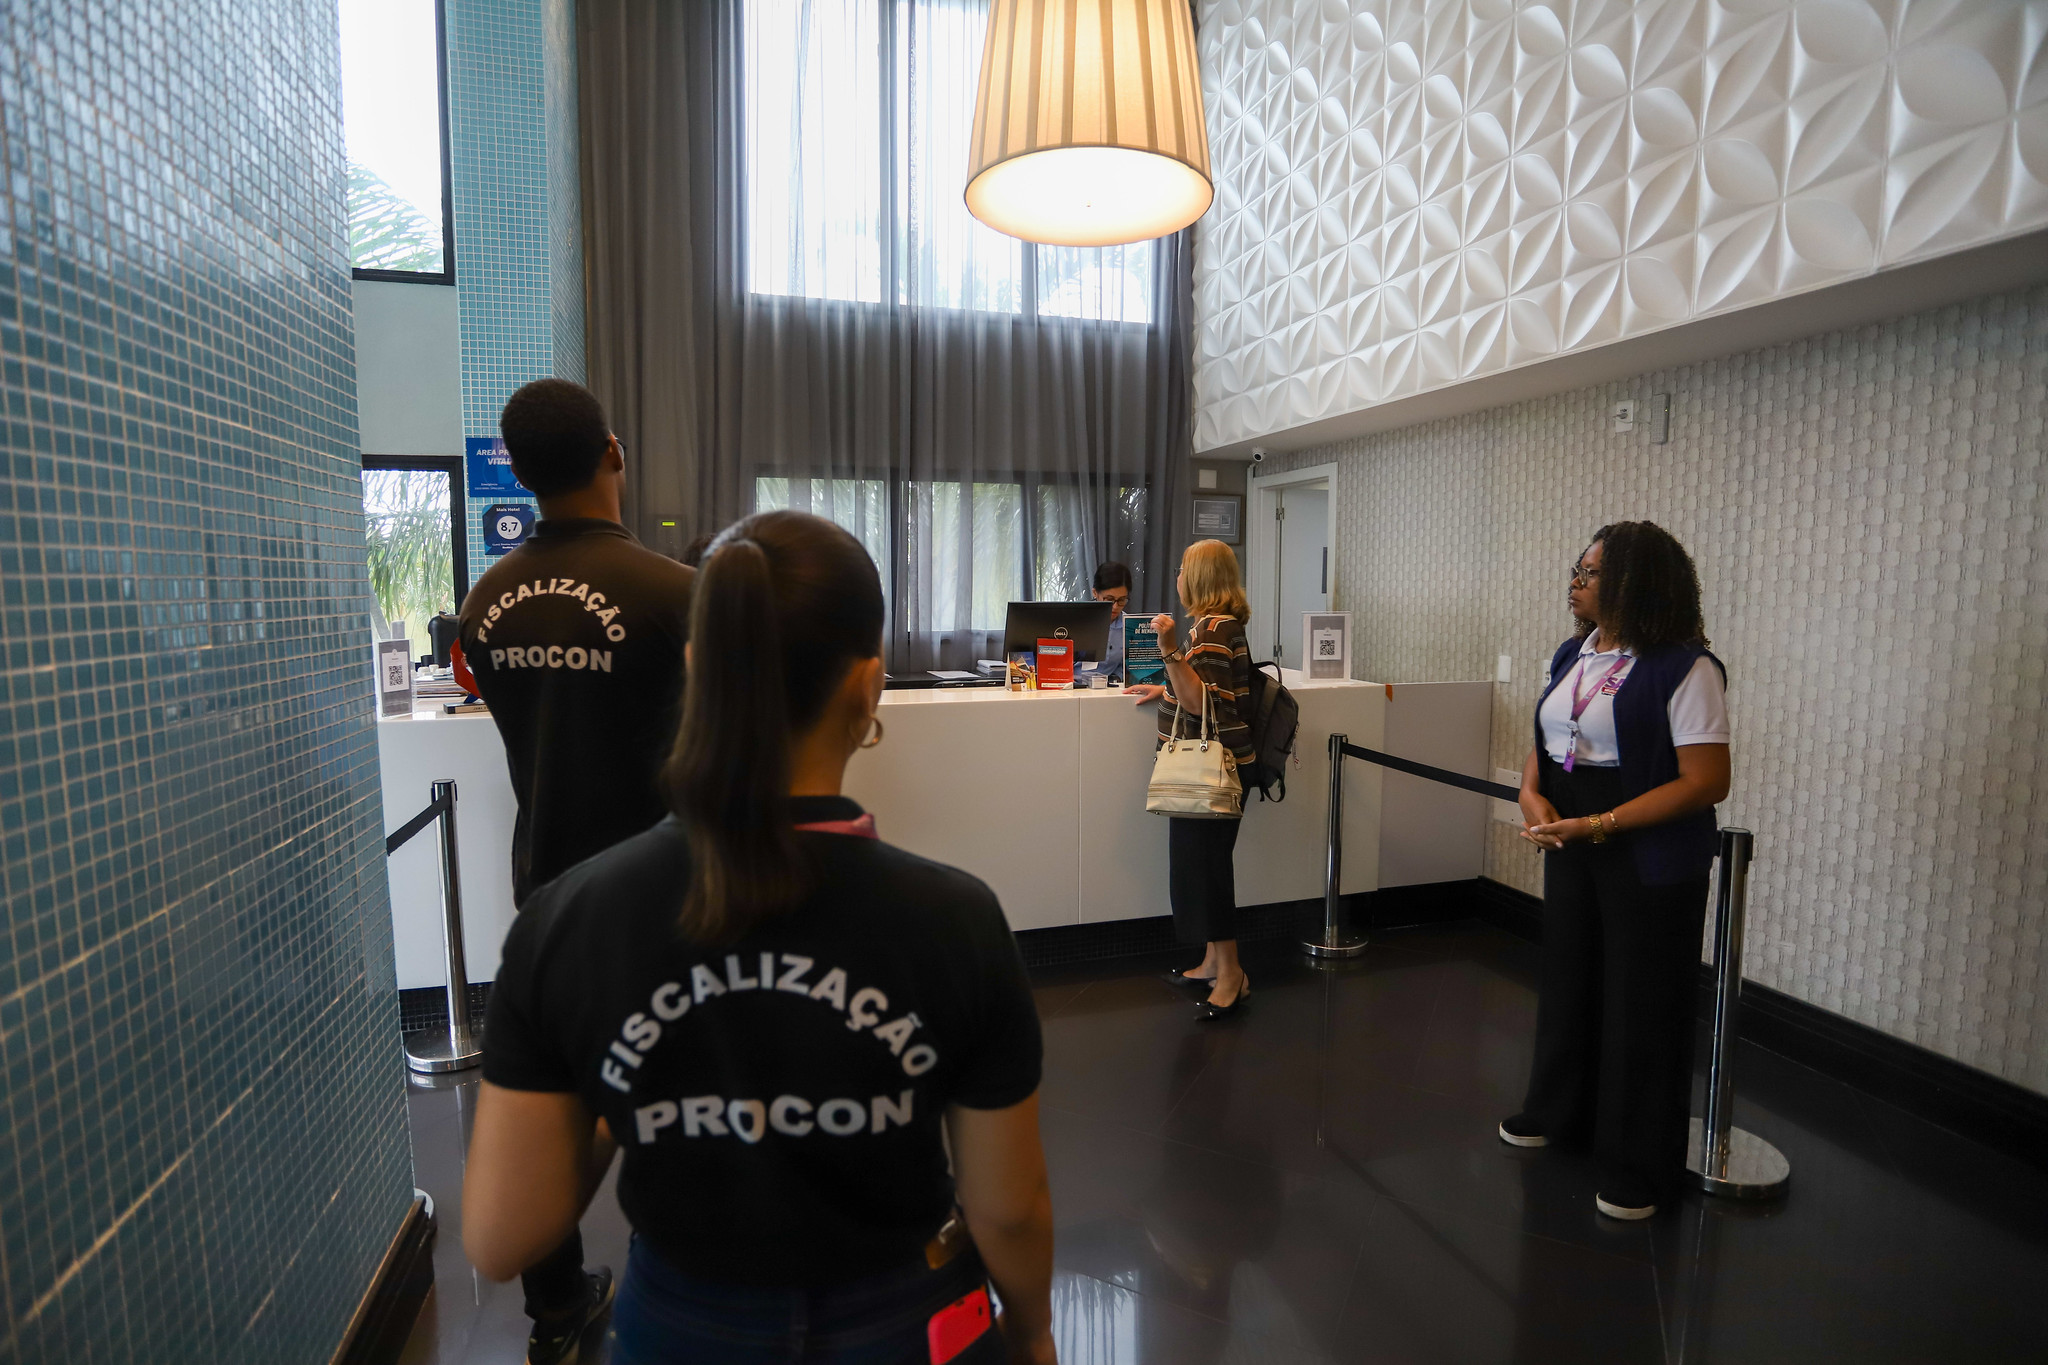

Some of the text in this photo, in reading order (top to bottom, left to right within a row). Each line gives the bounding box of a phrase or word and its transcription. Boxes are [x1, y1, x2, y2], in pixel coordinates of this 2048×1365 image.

[476, 448, 497, 456] ÁREA
[501, 522, 518, 532] 8,7
[478, 579, 625, 642] FISCALIZAÇÃO
[491, 646, 611, 672] PROCON
[601, 952, 937, 1093] FISCALIZAÇÃO
[635, 1089, 914, 1143] PROCON
